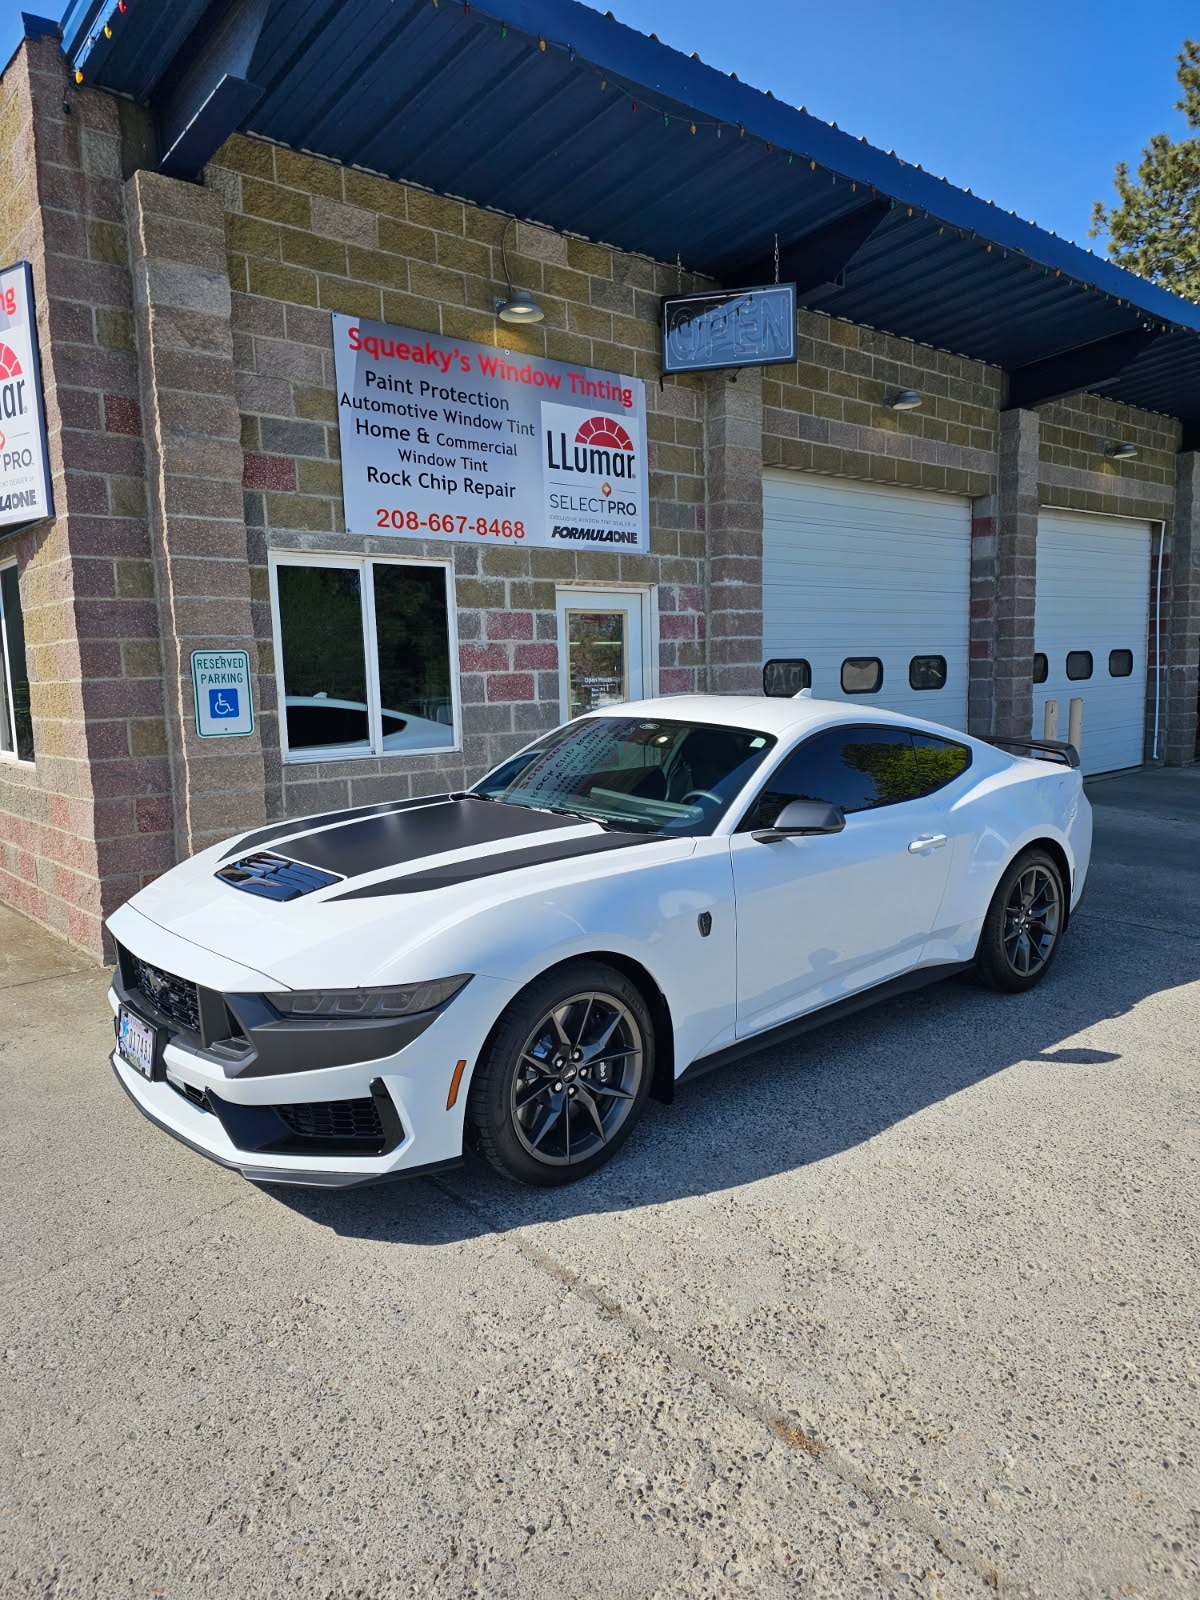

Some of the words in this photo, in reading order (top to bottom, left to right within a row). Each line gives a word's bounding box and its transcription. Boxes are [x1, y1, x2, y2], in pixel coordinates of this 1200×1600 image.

[669, 295, 790, 361] OPEN
[348, 327, 471, 373] Squeaky's
[477, 353, 562, 391] Window
[566, 371, 633, 408] Tinting
[365, 370, 413, 395] Paint
[420, 380, 510, 411] Protection
[340, 391, 438, 421] Automotive
[443, 408, 503, 431] Window
[507, 419, 535, 436] Tint
[356, 418, 411, 441] Home
[417, 427, 430, 444] &
[436, 433, 518, 456] Commercial
[547, 430, 635, 479] LLumar
[398, 448, 456, 468] Window
[460, 456, 488, 472] Tint
[367, 466, 412, 487] Rock
[418, 473, 458, 495] Chip
[464, 477, 516, 499] Repair
[376, 508, 525, 539] 208-667-8468
[197, 658, 244, 669] RESERVED
[201, 673, 243, 684] PARKING
